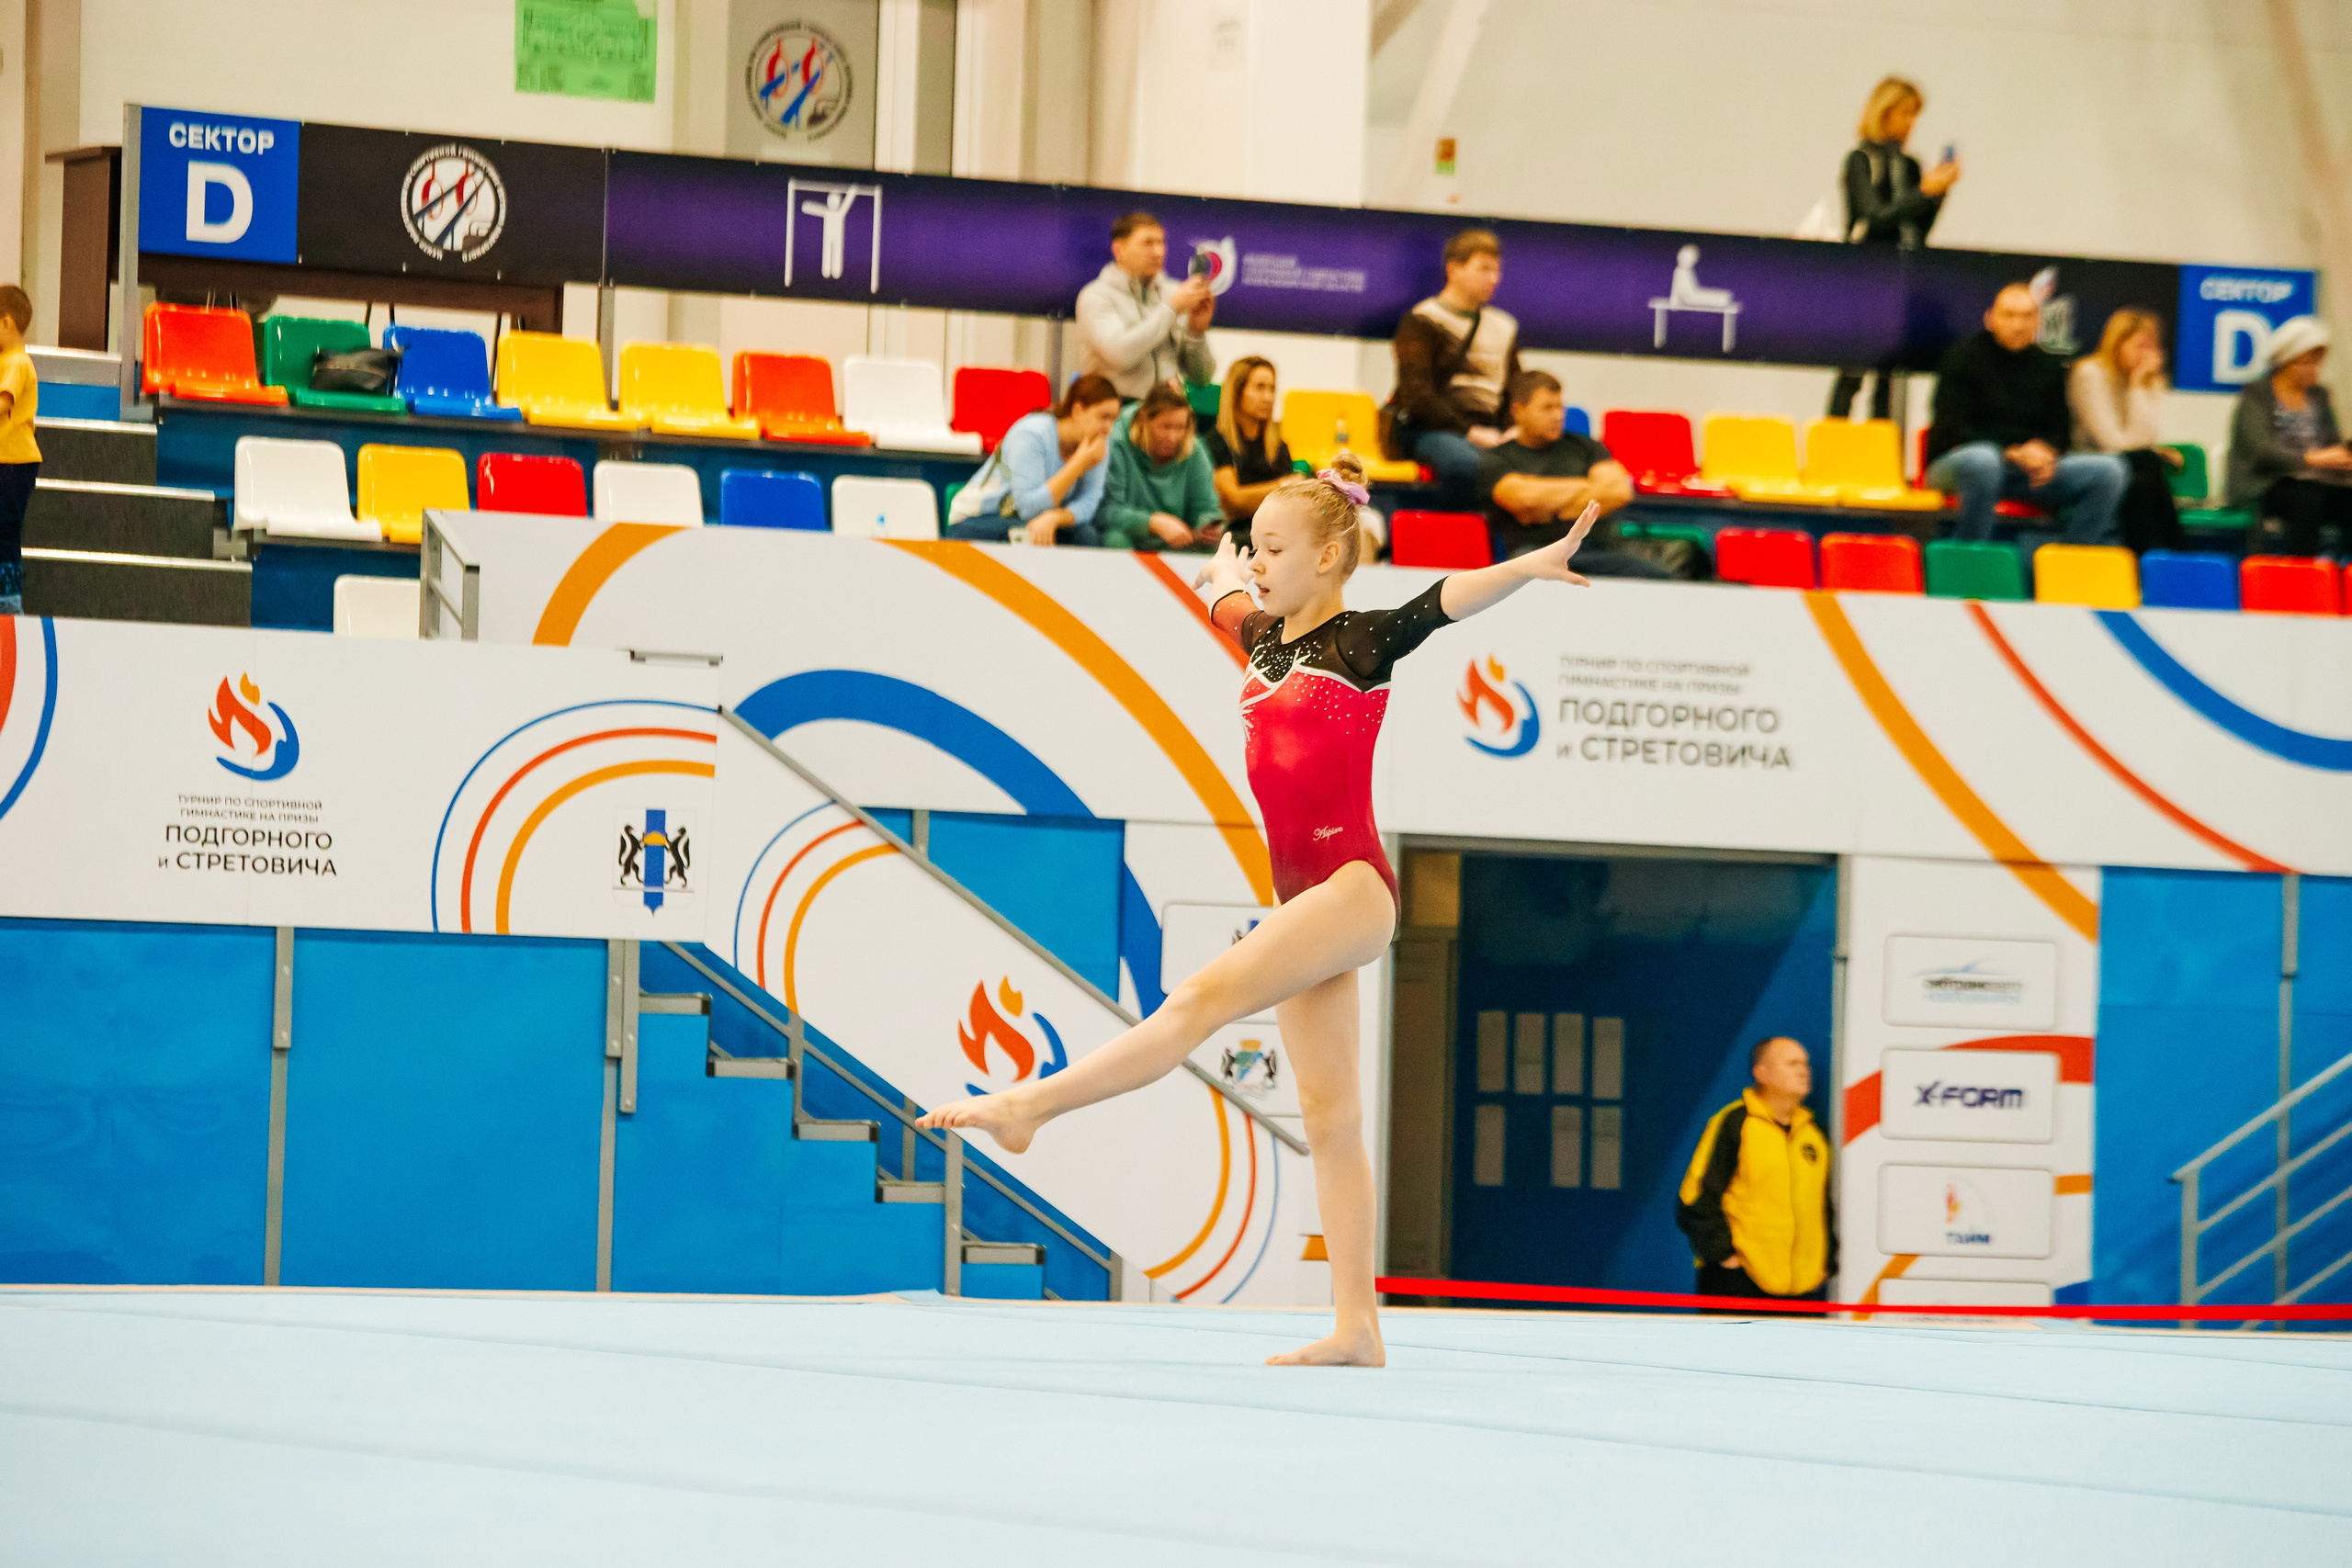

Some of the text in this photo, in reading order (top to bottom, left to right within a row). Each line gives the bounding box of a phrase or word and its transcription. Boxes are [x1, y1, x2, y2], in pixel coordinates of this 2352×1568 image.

[169, 121, 275, 155] СЕКТОР
[186, 160, 254, 244] D
[2212, 309, 2275, 385] D
[1559, 698, 1779, 734] ПОДГОРНОГО
[1579, 737, 1792, 771] СТРЕТОВИЧА
[178, 794, 322, 811] ТУРНИР ПО СПОРТИВНОЙ
[180, 807, 319, 824] ГИМНАСТИКЕ НА ПРИЗЫ
[165, 824, 334, 851] ПОДГОРНОГО
[158, 852, 338, 877] и СТРЕТОВИЧА
[1914, 1081, 2023, 1110] X-FORM
